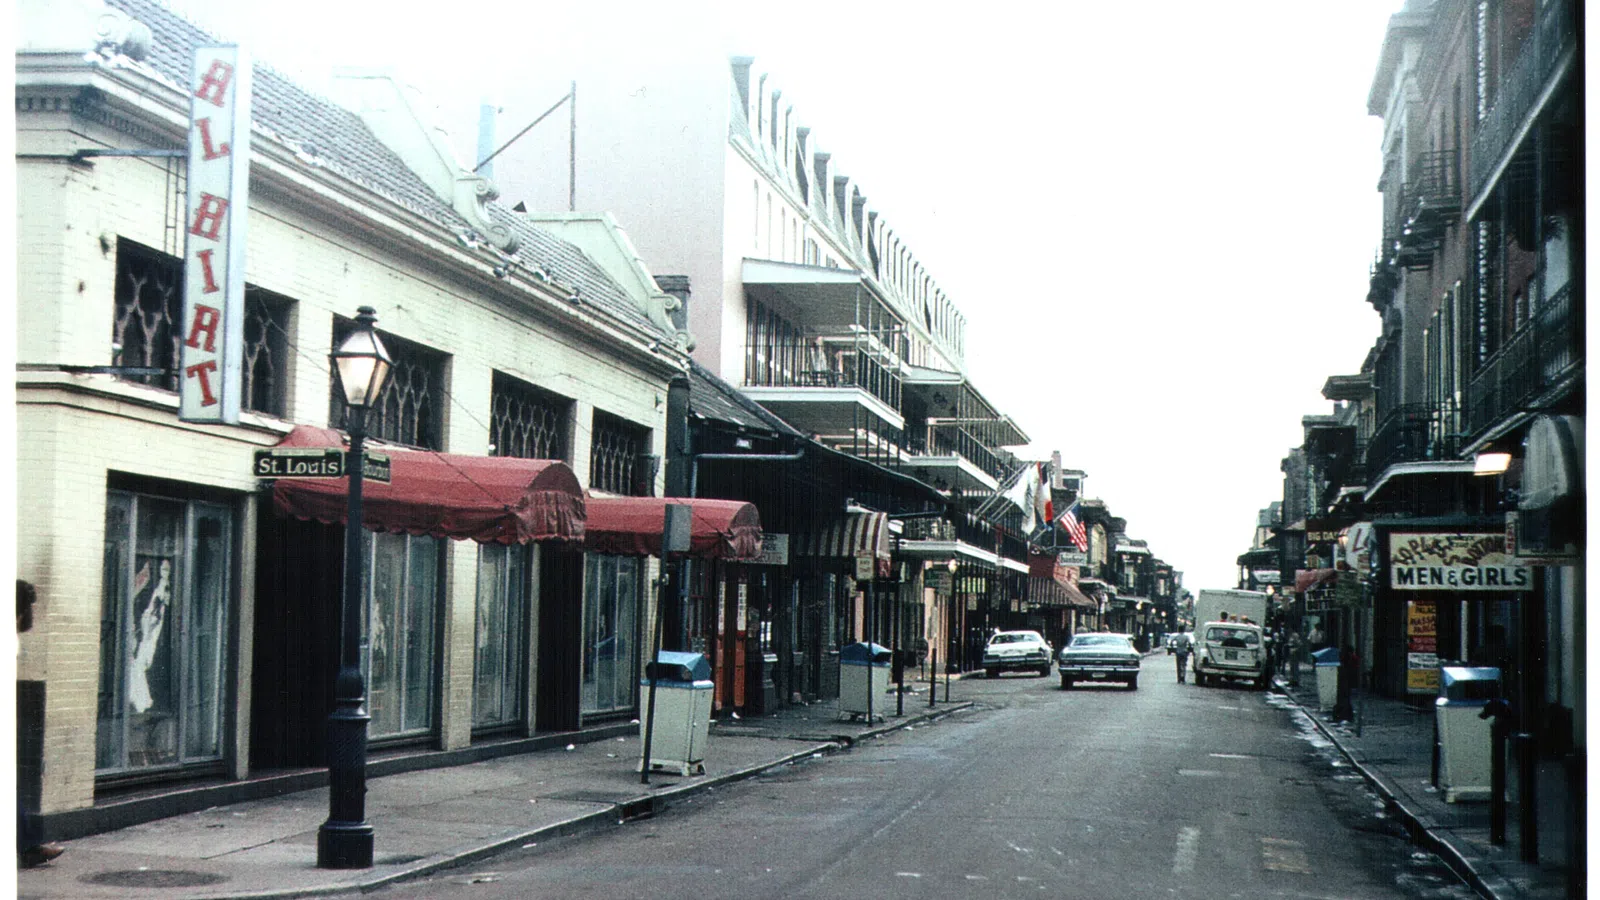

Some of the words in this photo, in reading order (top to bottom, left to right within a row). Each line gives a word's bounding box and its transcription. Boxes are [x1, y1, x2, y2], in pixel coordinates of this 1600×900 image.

[193, 57, 236, 162] AL
[184, 190, 230, 409] HIRT
[258, 457, 282, 474] St.
[286, 457, 340, 474] Louis
[1306, 531, 1322, 541] BIG
[1396, 567, 1444, 586] MEN
[1446, 569, 1459, 588] &
[1460, 567, 1528, 587] GIRLS
